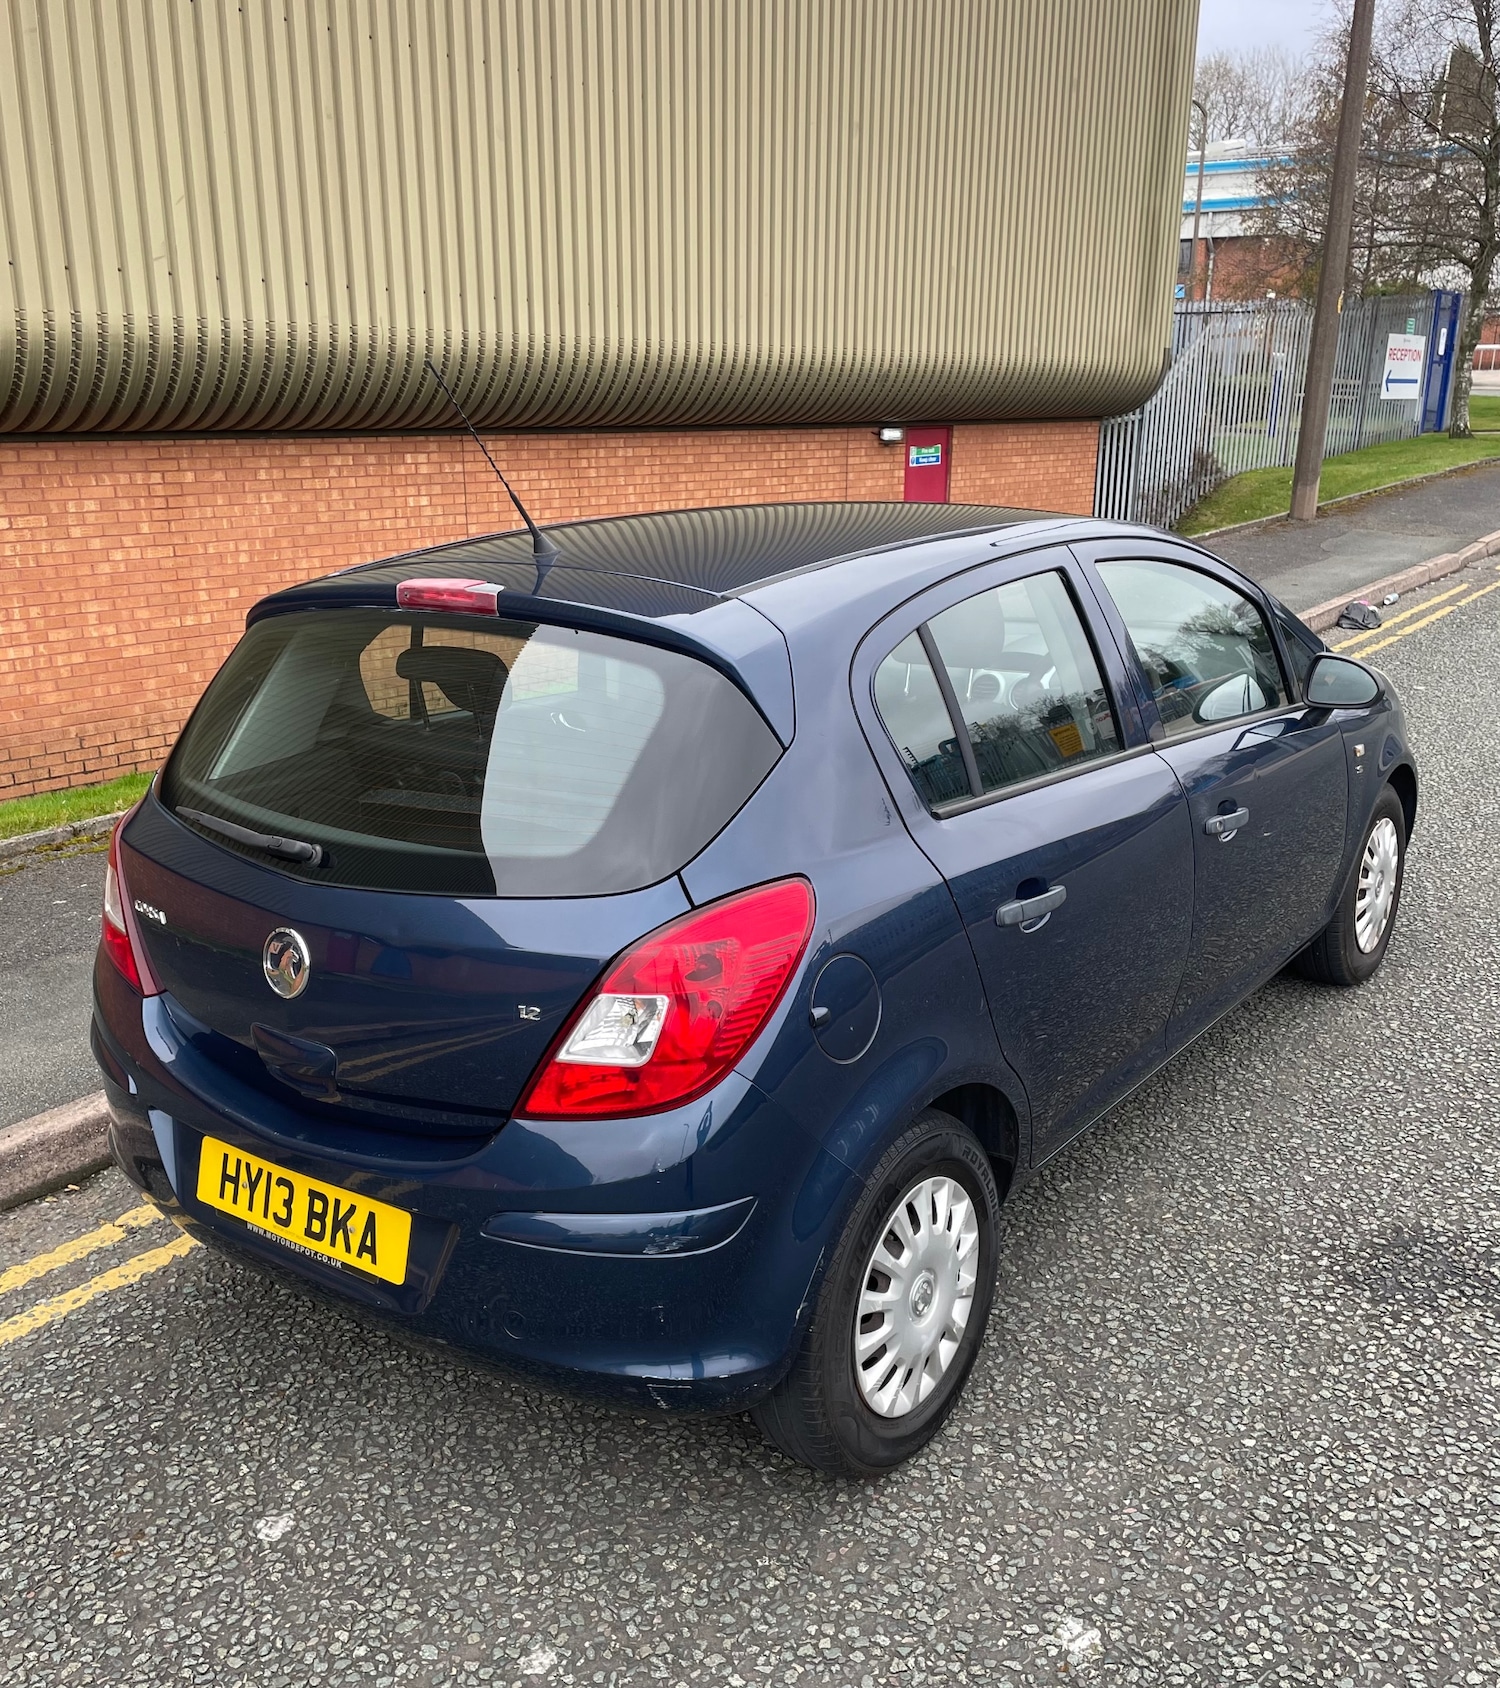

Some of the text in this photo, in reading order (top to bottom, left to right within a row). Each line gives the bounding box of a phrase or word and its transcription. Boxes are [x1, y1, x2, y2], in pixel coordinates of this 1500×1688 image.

[1388, 348, 1422, 362] RECEPTION
[219, 1152, 377, 1266] HY13 BKA
[246, 1222, 343, 1269] WWW.MOTORDEPOT.CO.UK
